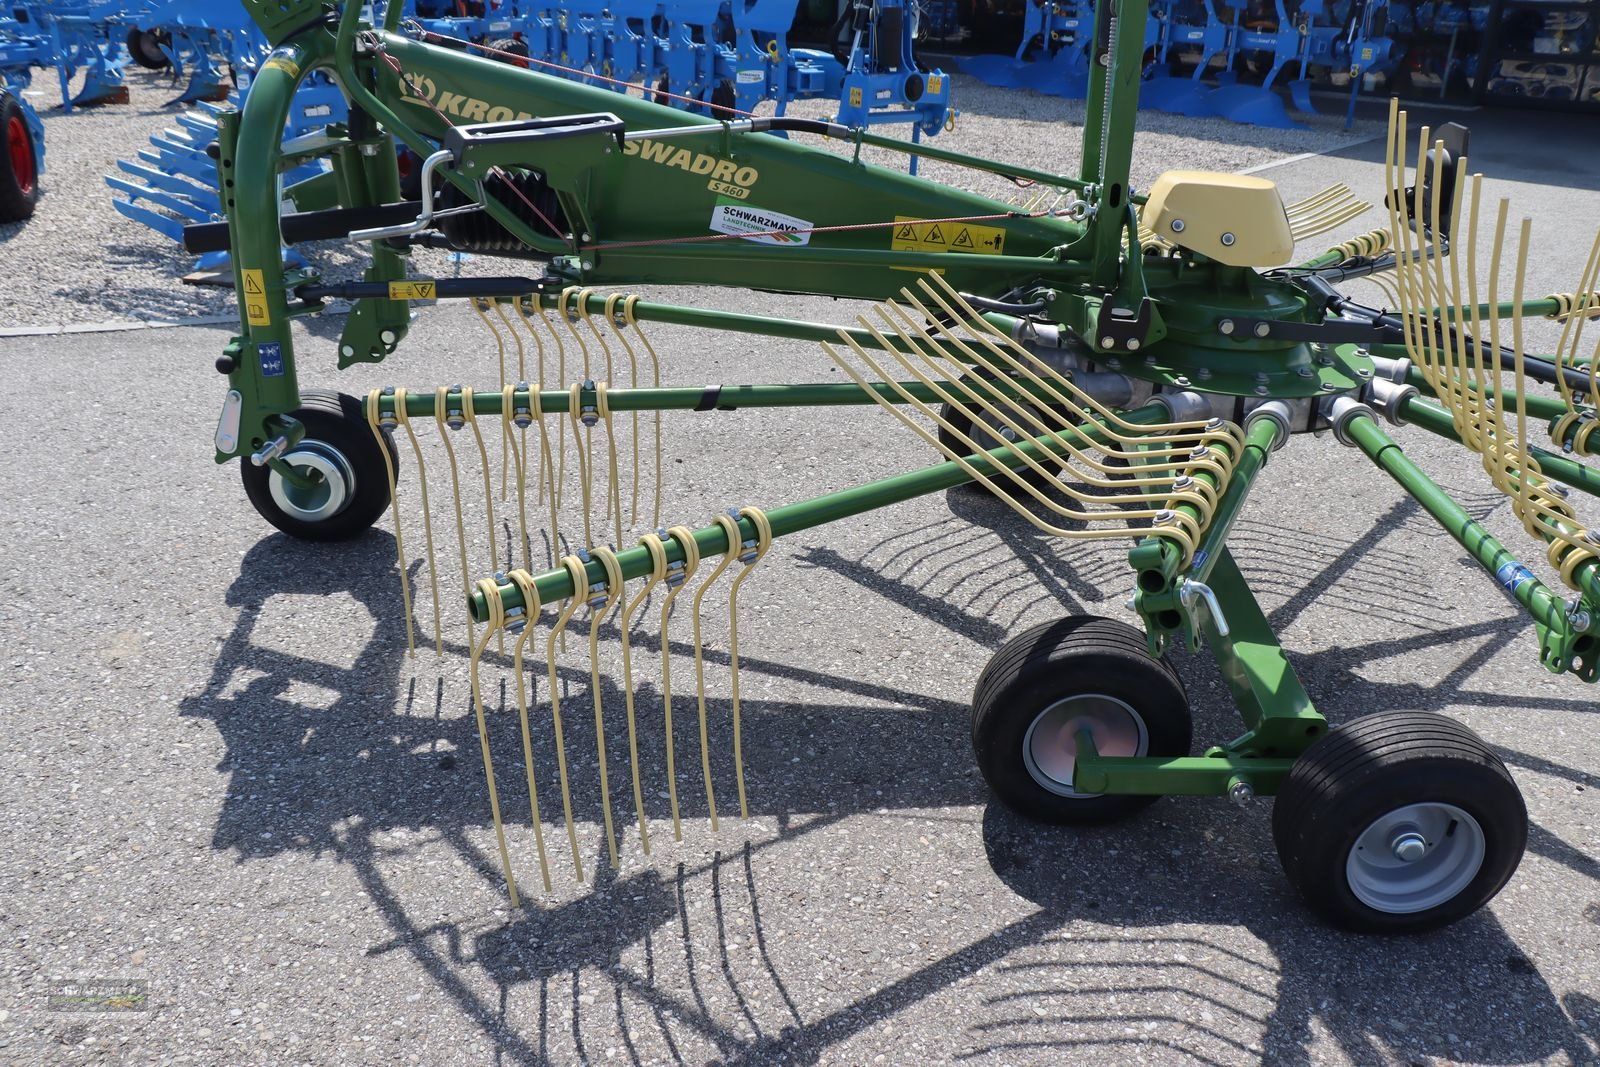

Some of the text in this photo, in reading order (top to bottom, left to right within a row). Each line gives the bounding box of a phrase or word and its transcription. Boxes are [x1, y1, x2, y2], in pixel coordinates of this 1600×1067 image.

[436, 91, 540, 123] KRO
[623, 139, 759, 187] SWADRO
[712, 182, 744, 197] S 460
[723, 216, 766, 232] LANDTECHNIK
